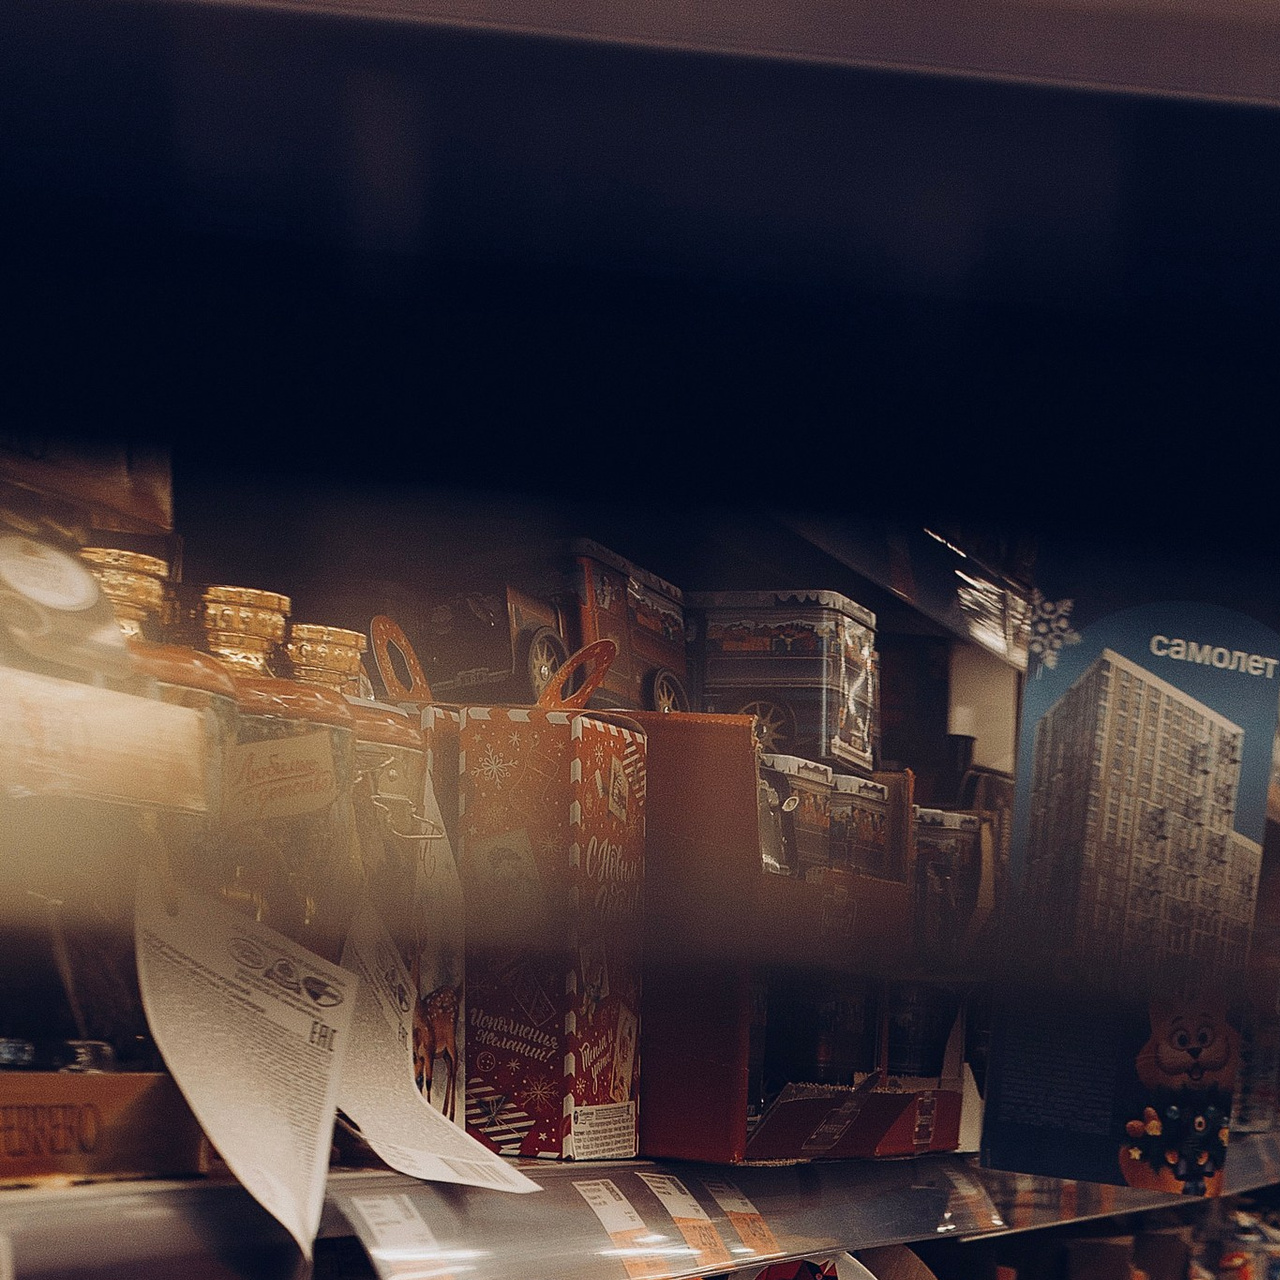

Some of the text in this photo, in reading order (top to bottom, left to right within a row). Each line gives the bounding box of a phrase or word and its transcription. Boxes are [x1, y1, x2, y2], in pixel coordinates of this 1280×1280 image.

[1150, 634, 1280, 679] самолет
[470, 1007, 559, 1049] Исполнения
[0, 1104, 101, 1156] ERRERO
